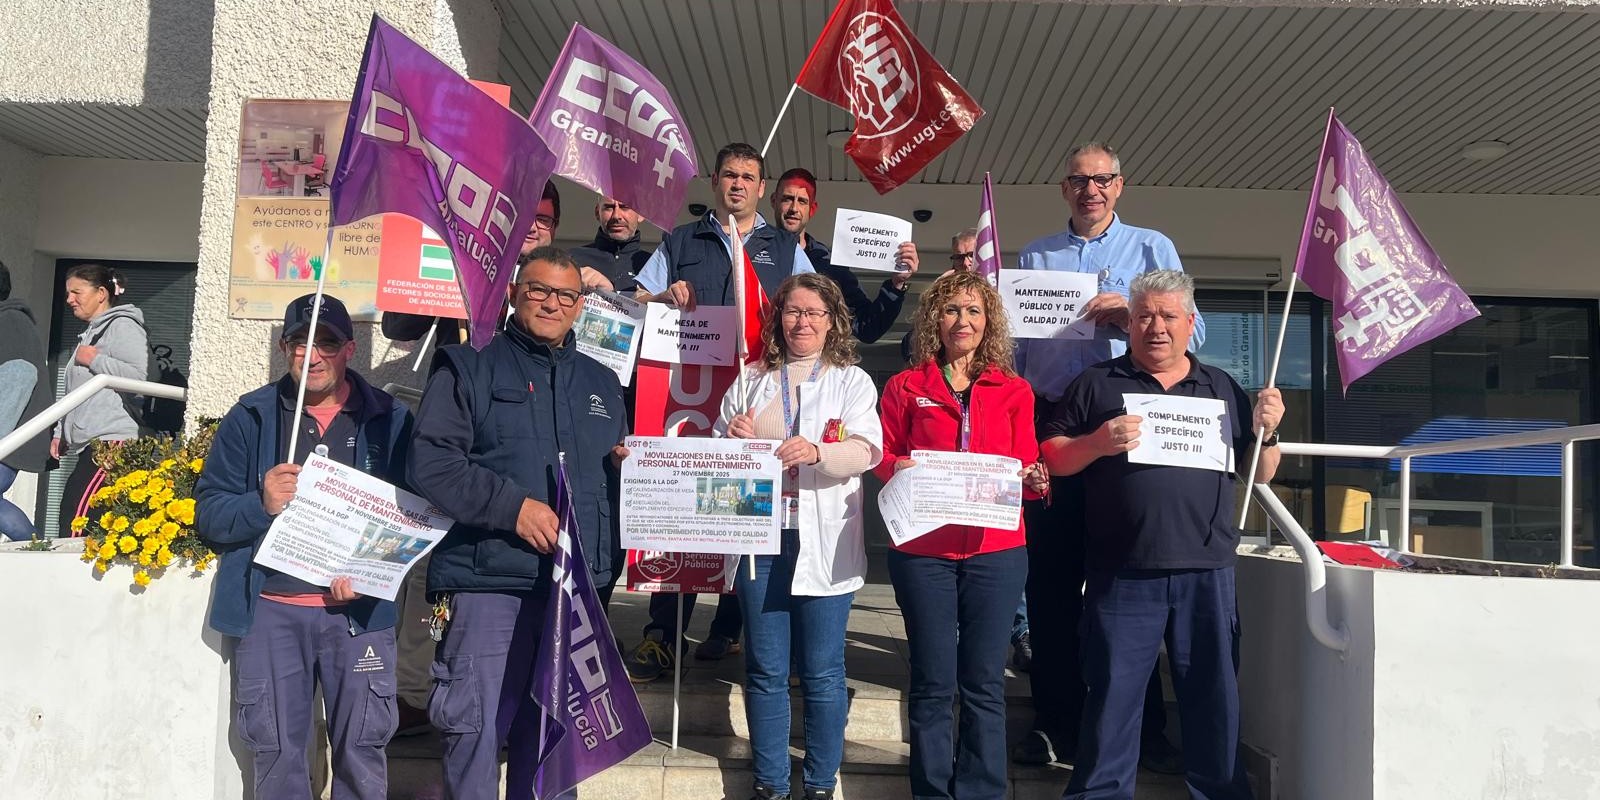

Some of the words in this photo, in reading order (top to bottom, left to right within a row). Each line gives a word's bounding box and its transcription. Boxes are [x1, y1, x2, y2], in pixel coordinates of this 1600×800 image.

[551, 108, 640, 164] Granada
[253, 205, 311, 216] Ayúdanos
[252, 220, 272, 228] este
[274, 220, 313, 228] CENTRO
[316, 222, 322, 230] y
[339, 232, 362, 242] libre
[366, 232, 380, 242] de
[850, 226, 898, 238] COMPLEMENTO
[853, 238, 890, 248] ESPECÍFICO
[856, 250, 876, 258] JUSTO
[386, 279, 434, 290] FEDERACIÓN
[382, 286, 422, 296] SECTORES
[1015, 288, 1081, 298] MANTENIMIENTO
[584, 297, 629, 315] NTENIMIENTO
[1019, 300, 1052, 312] PÚBLICO
[1055, 304, 1062, 312] Y
[1064, 304, 1075, 312] DE
[675, 319, 696, 328] MESA
[698, 320, 709, 328] DE
[1023, 316, 1058, 324] CALIDAD
[657, 329, 721, 341] MANTENIMIENTO
[1240, 354, 1250, 366] de
[1241, 370, 1250, 385] Sur
[1148, 412, 1210, 426] COMPLEMENTO
[1154, 426, 1204, 439] ESPECÍFICO
[1161, 442, 1189, 452] JUSTO
[644, 452, 704, 460] MOVILIZACIONES
[312, 460, 328, 470] UGT
[638, 460, 680, 468] PERSONAL
[692, 461, 762, 470] MANTENIMIENTO
[325, 476, 384, 506] MOVILIZACIONES
[385, 500, 396, 510] EN
[404, 510, 419, 520] SAS
[418, 514, 430, 524] DEL
[296, 495, 322, 510] XIGIMOS
[326, 508, 335, 516] LA
[336, 512, 350, 520] DGP
[314, 481, 356, 505] PERSONAL
[358, 500, 370, 510] DE
[370, 504, 432, 531] MANTENIMIENTO
[354, 509, 389, 526] NOVIEMBRE
[388, 522, 402, 532] 2025
[270, 543, 286, 554] POR
[285, 548, 296, 558] UN
[684, 552, 722, 560] Servicios
[684, 560, 720, 569] Públicos
